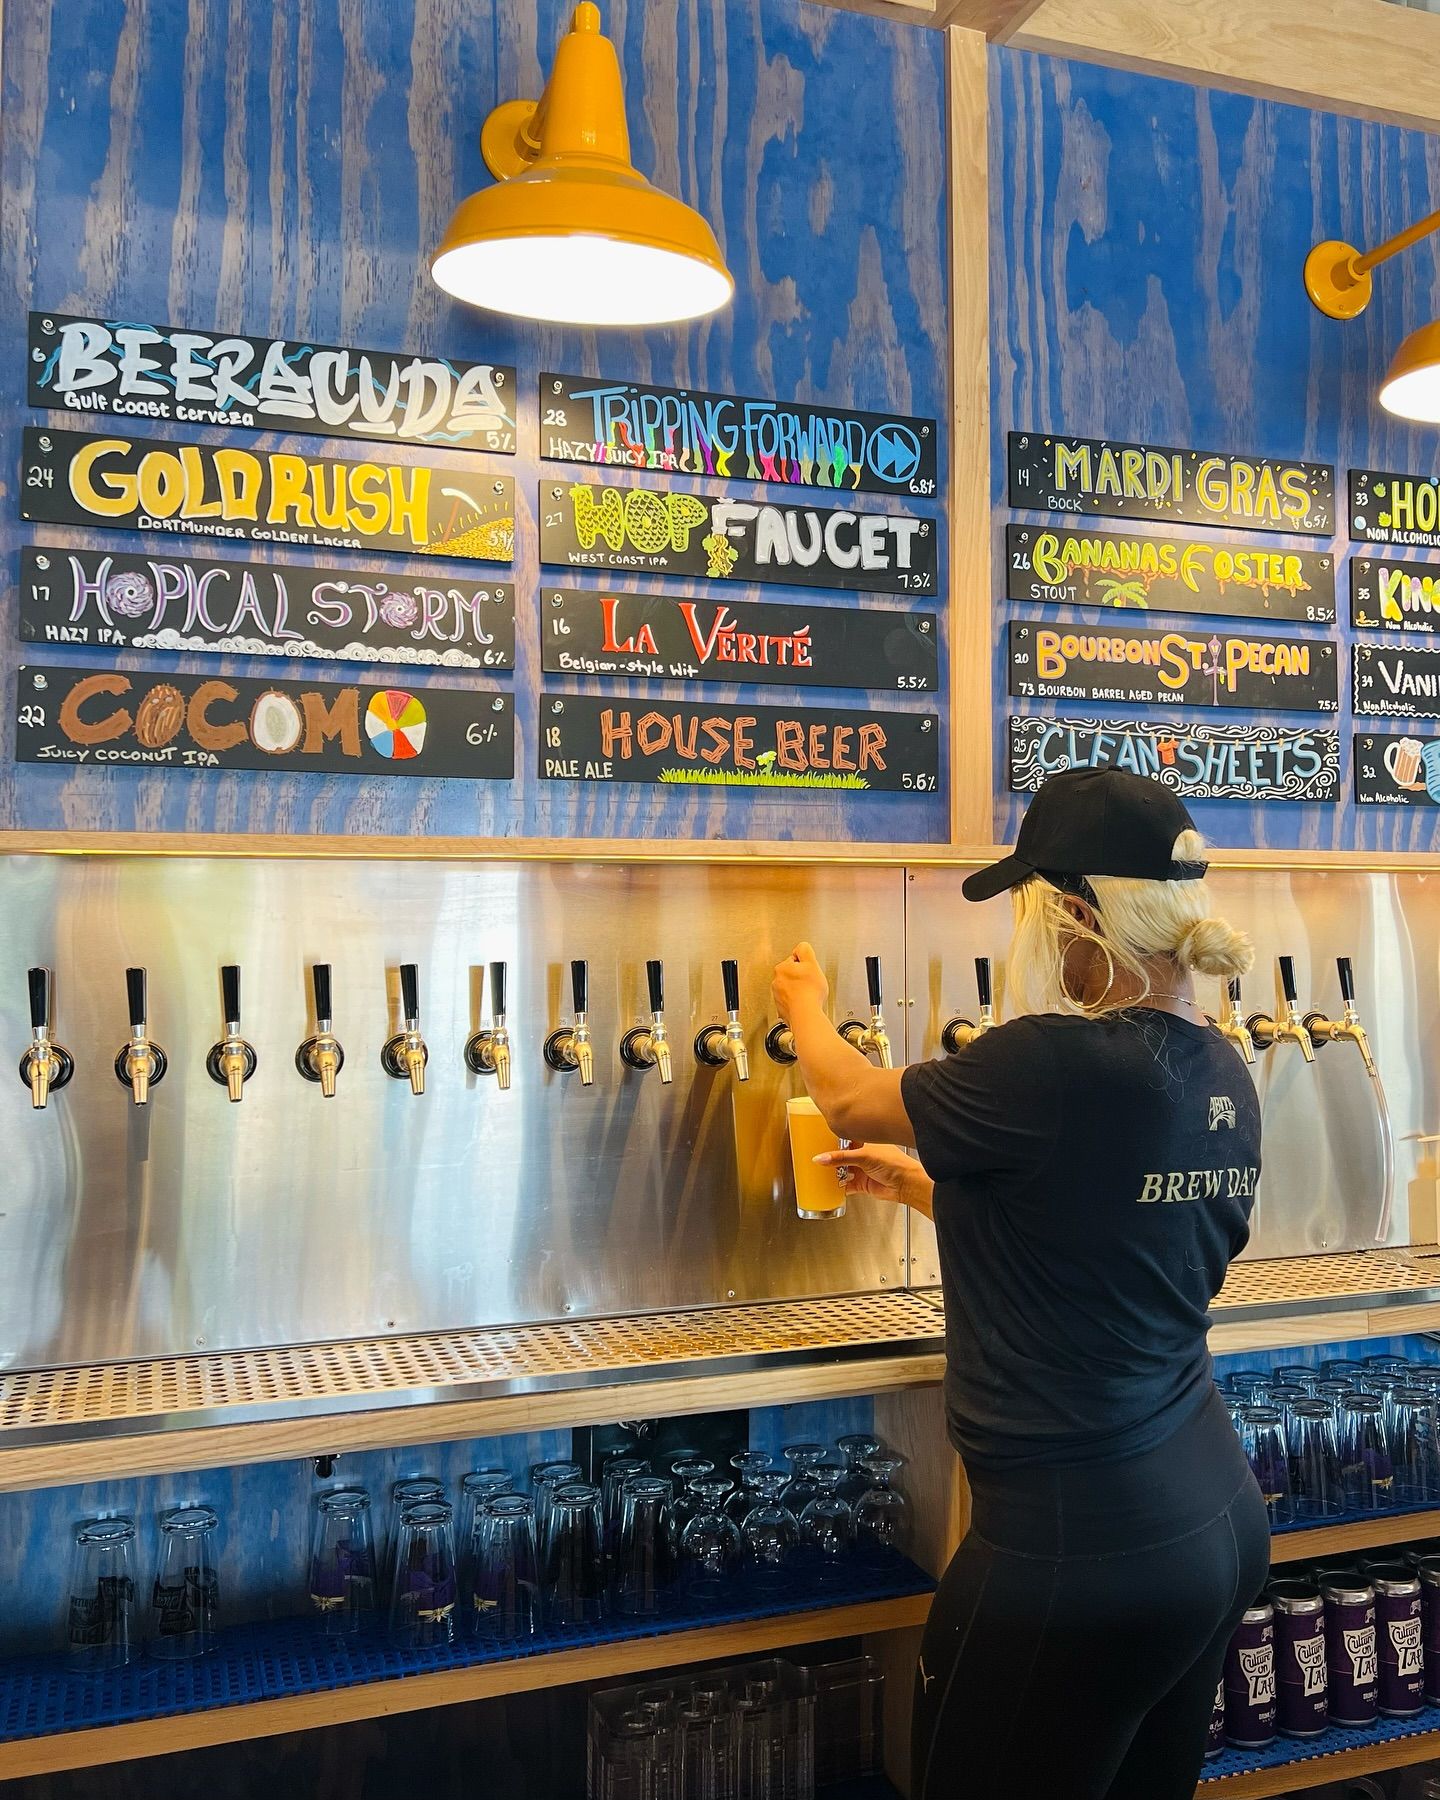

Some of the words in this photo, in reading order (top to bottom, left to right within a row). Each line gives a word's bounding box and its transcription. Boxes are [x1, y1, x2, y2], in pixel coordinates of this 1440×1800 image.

[32, 347, 46, 362] 6
[53, 322, 506, 438] BEERACUDA
[64, 391, 107, 411] Gulf
[543, 409, 567, 427] 28
[487, 431, 515, 450] 5%
[569, 386, 738, 467] TRIPPING
[742, 402, 866, 480] FORWARD
[647, 450, 680, 470] IPA
[27, 466, 54, 488] 24
[909, 478, 936, 495] 6.8%
[1018, 468, 1029, 487] 14
[1055, 442, 1183, 502] MARDI
[1196, 459, 1311, 520] GRAS
[69, 439, 262, 522] GOLD
[267, 453, 432, 545] RUSH
[1355, 492, 1369, 507] 33
[1047, 495, 1083, 513] BOCK
[1391, 480, 1440, 532] HO
[545, 512, 564, 527] 27
[570, 483, 708, 553] HOP
[711, 500, 921, 570] FAUCET
[1303, 514, 1329, 529] 6.5%
[138, 515, 246, 539] DORTMUNDER
[251, 527, 309, 544] GOLDEN
[313, 533, 362, 549] LAGER
[1366, 527, 1389, 541] NON
[568, 552, 605, 564] WEST
[608, 553, 646, 567] COAST
[649, 556, 669, 567] IPA
[1012, 552, 1031, 570] 26
[1033, 533, 1177, 584] BANANAS
[1181, 543, 1303, 593] FOSTER
[898, 572, 932, 590] 7.3%
[32, 585, 50, 601] 17
[69, 556, 304, 641] HOPICAL
[306, 580, 493, 645] STORM
[1030, 583, 1077, 601] STOUT
[1357, 587, 1371, 600] 35
[1306, 605, 1335, 622] 8.5%
[45, 625, 89, 643] HAZY
[97, 629, 126, 645] IPA
[552, 618, 570, 635] 16
[483, 649, 508, 666] 6%
[559, 652, 665, 678] Belgian-style
[1014, 653, 1029, 664] 20
[1036, 630, 1161, 680] BOURBON
[1226, 638, 1310, 693] PECAN
[897, 676, 928, 690] 5.5%
[1361, 675, 1374, 688] 34
[1377, 660, 1440, 698] VANI
[1018, 682, 1034, 696] 73
[1038, 683, 1086, 698] BOURBON
[1092, 687, 1126, 701] BARREL
[1128, 689, 1153, 702] AGED
[1157, 691, 1184, 703] PECAN
[18, 704, 45, 727] 22
[466, 721, 498, 745] 6%
[546, 727, 562, 748] 18
[600, 708, 756, 769] HOUSE
[776, 719, 887, 771] BEER
[1013, 737, 1026, 753] 25
[37, 744, 90, 763] JUICY
[95, 746, 178, 763] COCONUT
[182, 750, 219, 767] IPA
[1176, 736, 1322, 786] SHEETS
[545, 759, 581, 778] PALE
[584, 760, 614, 778] ALE
[1362, 765, 1377, 779] 32
[903, 772, 937, 791] 5.6%
[1306, 787, 1333, 800] 6.0%
[1136, 1169, 1224, 1204] BREW
